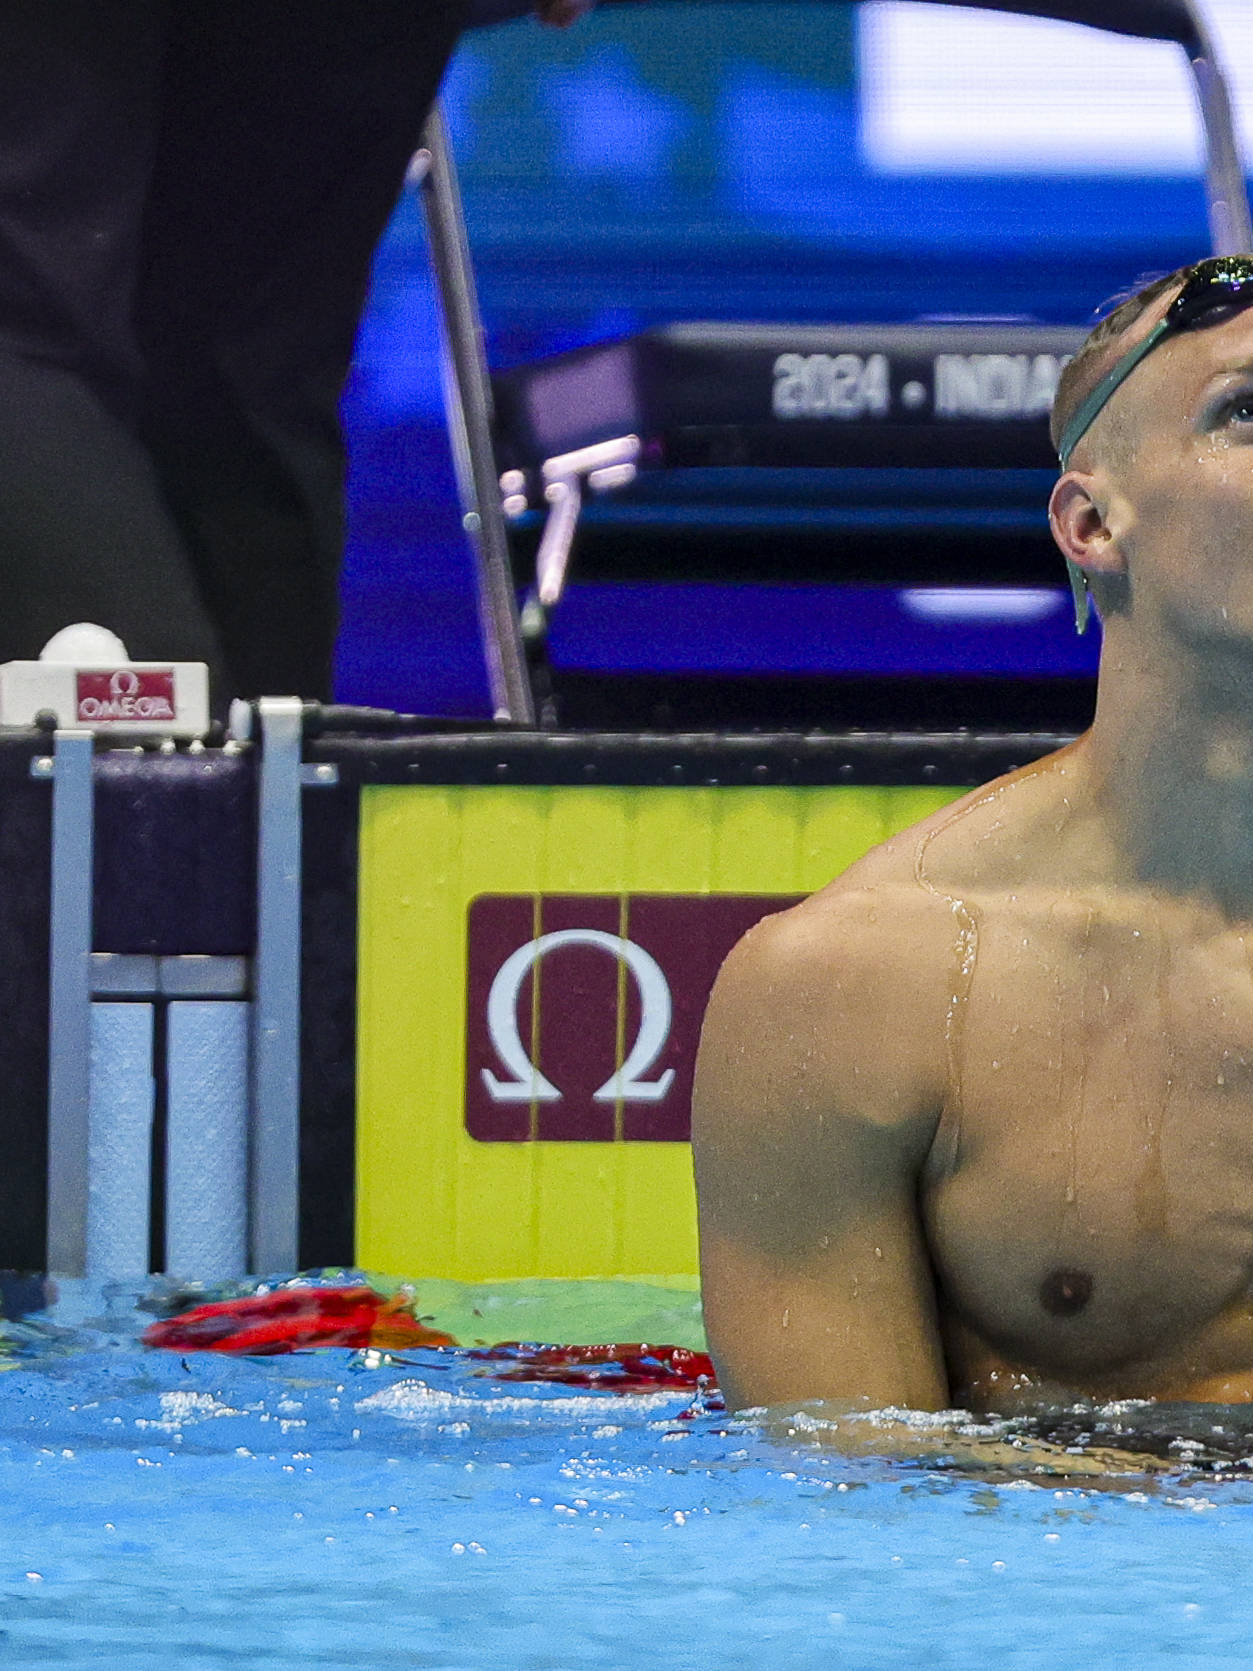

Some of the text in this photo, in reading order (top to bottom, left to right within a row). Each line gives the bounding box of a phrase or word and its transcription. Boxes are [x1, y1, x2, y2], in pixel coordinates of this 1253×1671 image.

[772, 352, 1073, 418] 2024 INDIA
[80, 696, 174, 717] OMEGA
